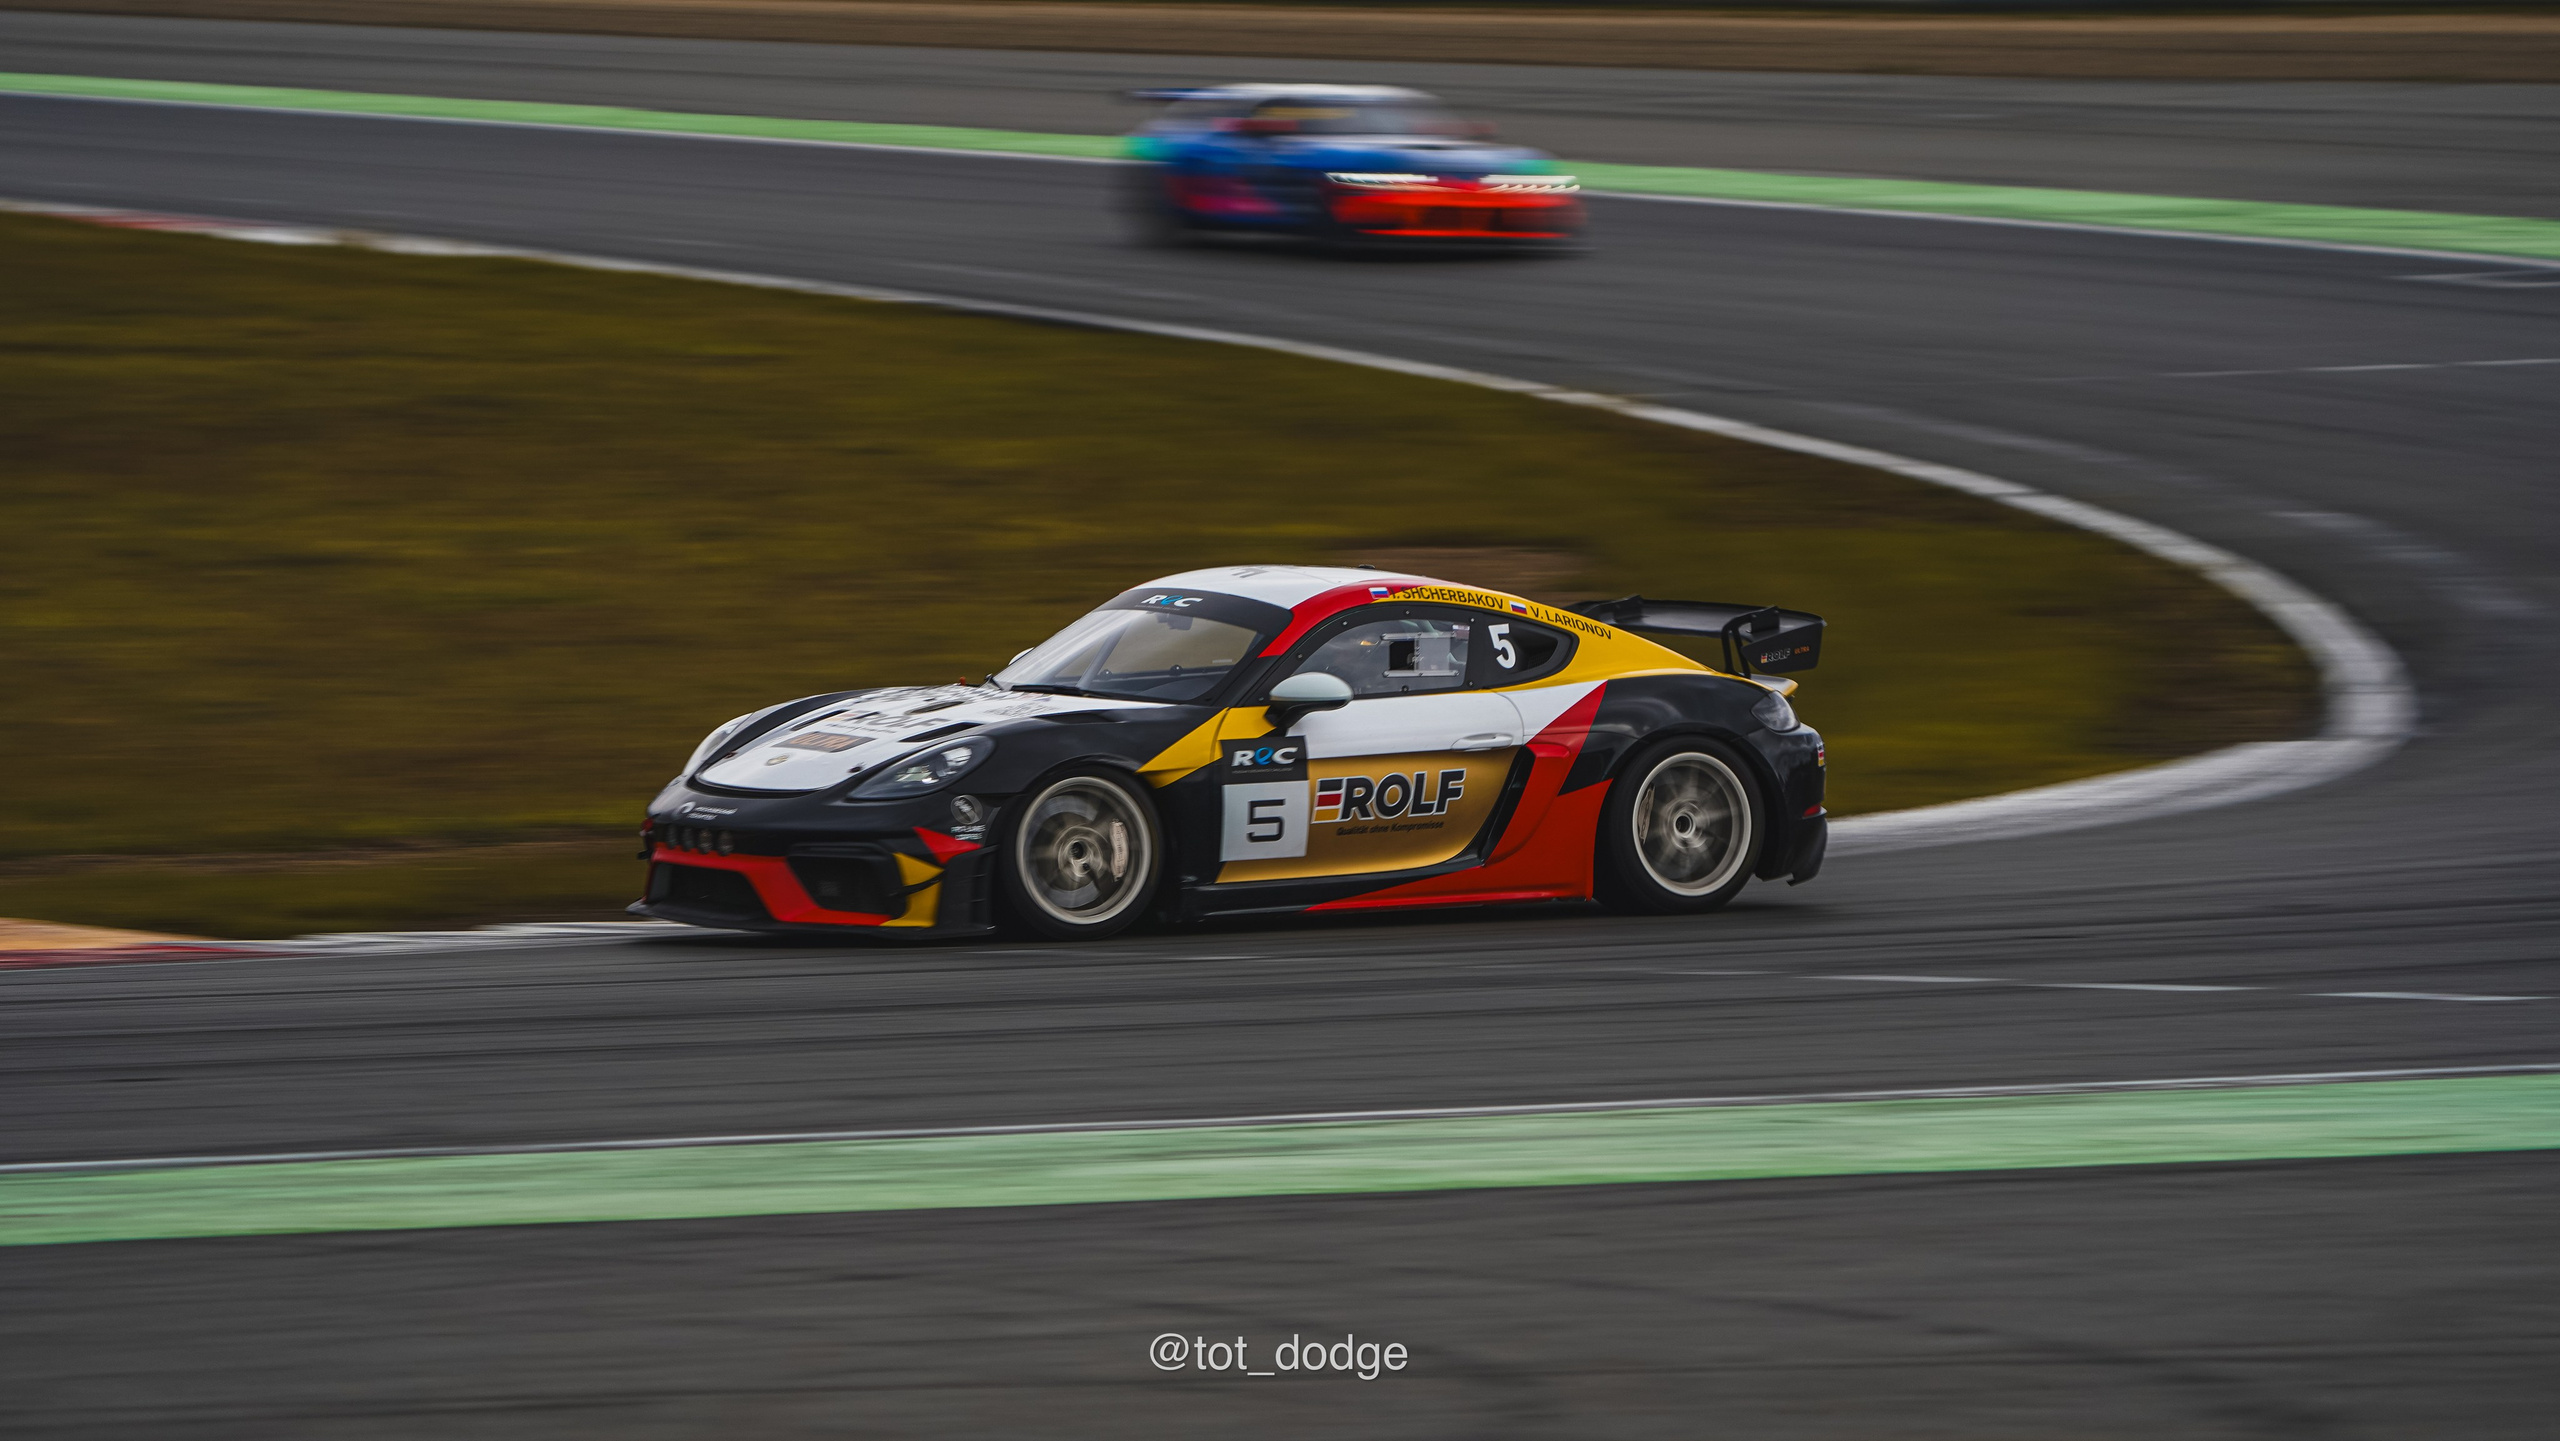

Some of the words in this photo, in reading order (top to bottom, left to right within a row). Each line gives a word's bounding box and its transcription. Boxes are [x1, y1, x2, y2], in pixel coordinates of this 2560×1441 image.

[1401, 586, 1504, 609] SHCHERBAKOV
[1530, 605, 1544, 619] V.
[1544, 609, 1611, 640] LARIONOV
[1488, 623, 1517, 669] 5
[1338, 768, 1467, 822] ROLF
[1246, 798, 1286, 843] 5
